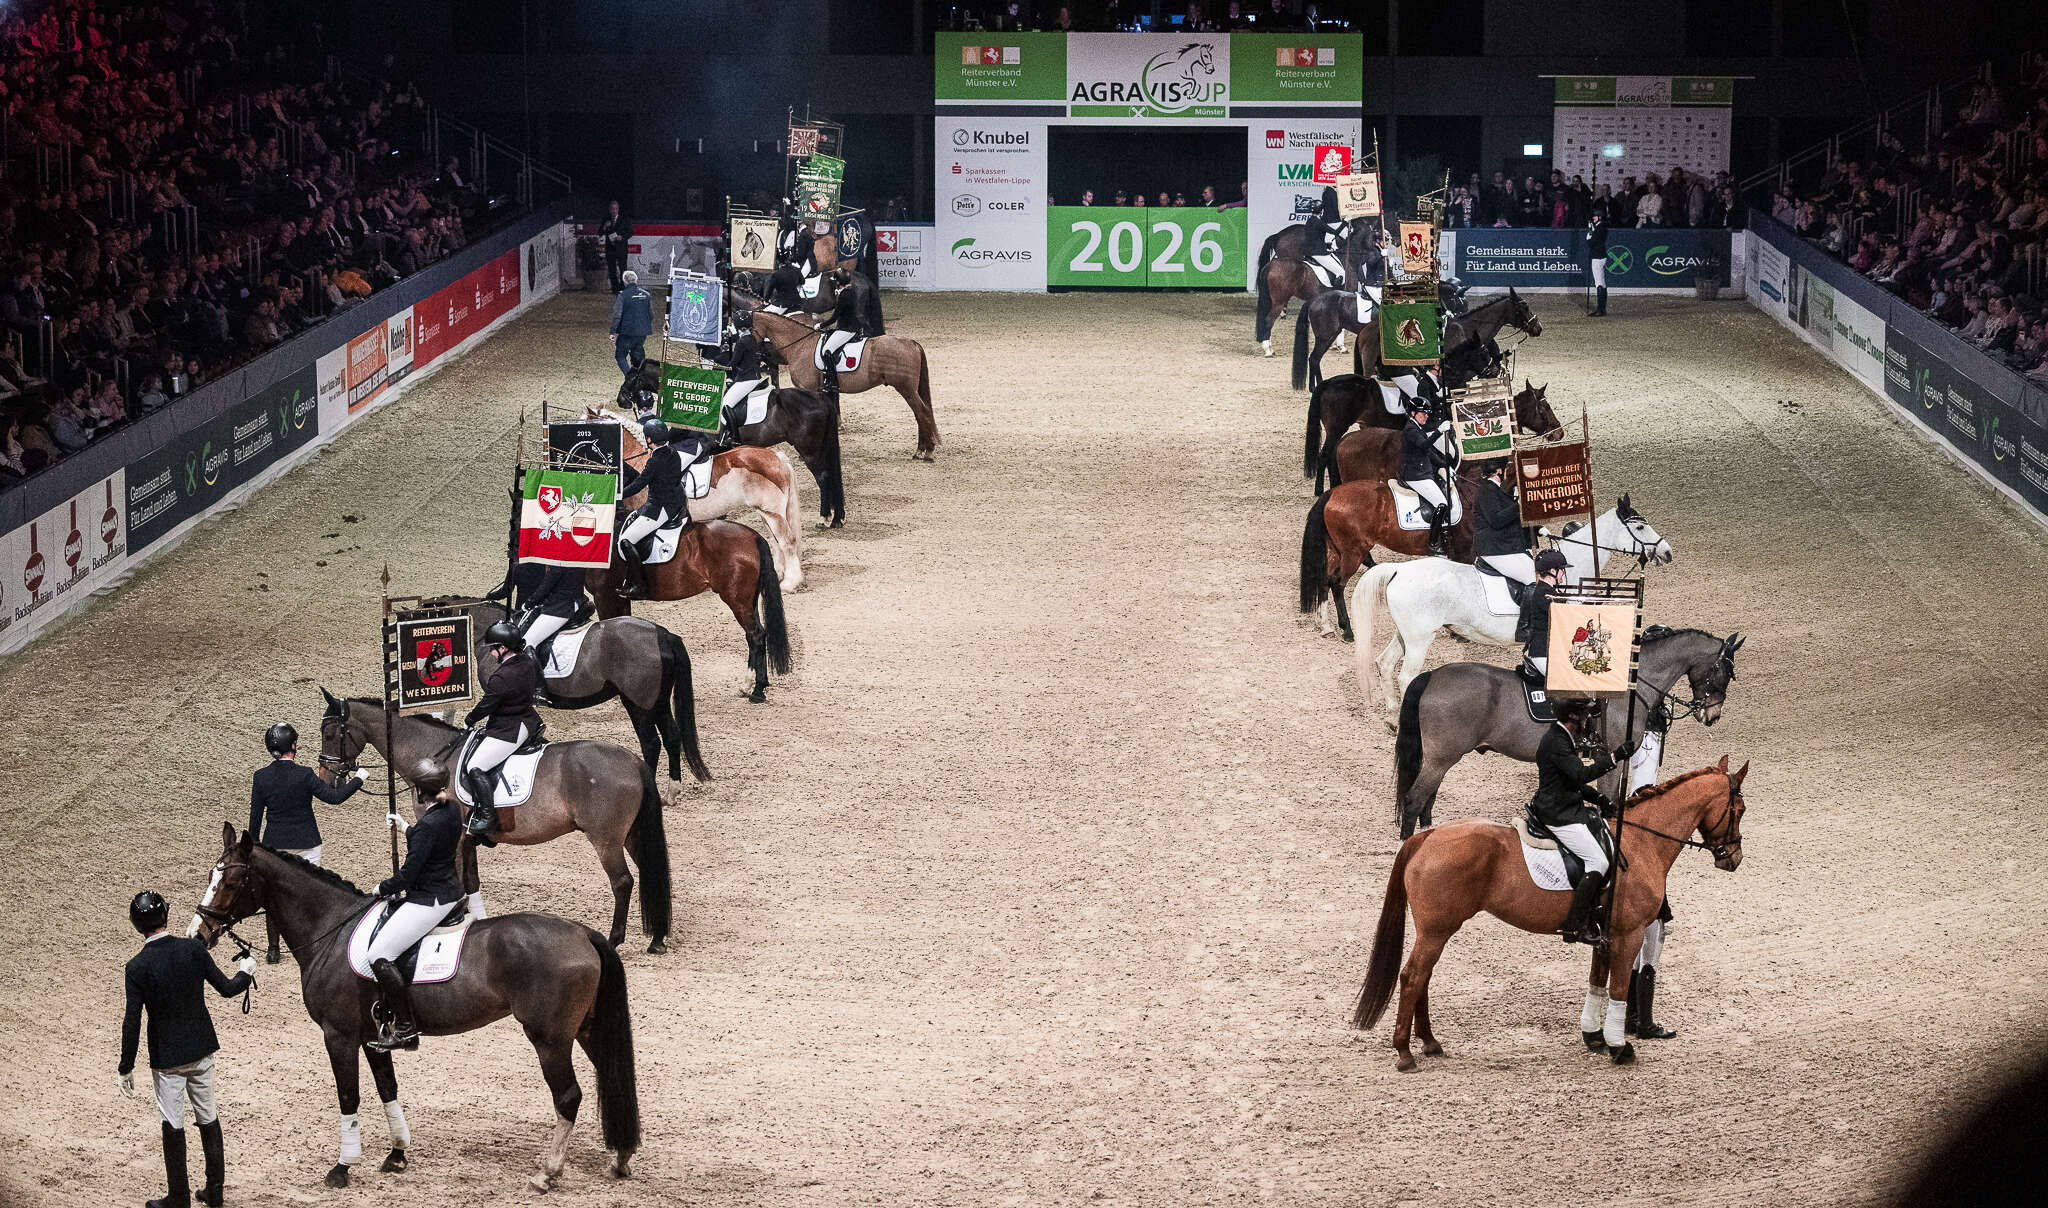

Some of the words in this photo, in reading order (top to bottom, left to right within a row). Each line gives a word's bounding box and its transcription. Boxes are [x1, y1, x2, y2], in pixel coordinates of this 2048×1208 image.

[961, 68, 1021, 76] Reiterverband
[1275, 69, 1336, 77] Reiterverband
[965, 78, 1001, 87] Münster
[1003, 79, 1017, 87] e.V.
[1279, 80, 1315, 88] Münster
[1316, 80, 1332, 88] e.V.
[1072, 82, 1182, 102] AGRAVIS
[1195, 108, 1224, 116] Münster
[973, 131, 1029, 145] Knubel
[1289, 131, 1344, 140] Westfälische
[1266, 137, 1284, 148] WN
[1278, 164, 1314, 180] LVM
[988, 202, 1025, 210] COLER
[1069, 221, 1223, 273] 2026
[1466, 246, 1534, 256] Gemeinsam
[1536, 246, 1567, 256] stark.
[958, 250, 1032, 260] AGRAVIS
[1465, 261, 1486, 271] Für
[1488, 261, 1516, 271] Land
[1519, 261, 1541, 271] und
[1543, 261, 1581, 271] Leben.
[900, 268, 916, 278] e.V.
[667, 378, 720, 393] REITERVEREIN
[685, 392, 711, 403] GEORG
[295, 396, 315, 418] AGRAVIS
[672, 401, 709, 415] MÜNSTER
[205, 448, 228, 475] AGRAVIS
[1525, 480, 1540, 489] UND
[1541, 474, 1582, 487] FAHRVEREIN
[131, 476, 160, 502] Gemeinsam
[1527, 484, 1584, 502] RINKERODE
[413, 624, 456, 638] REITERVEREIN
[406, 683, 465, 698] WESTBEVERN
